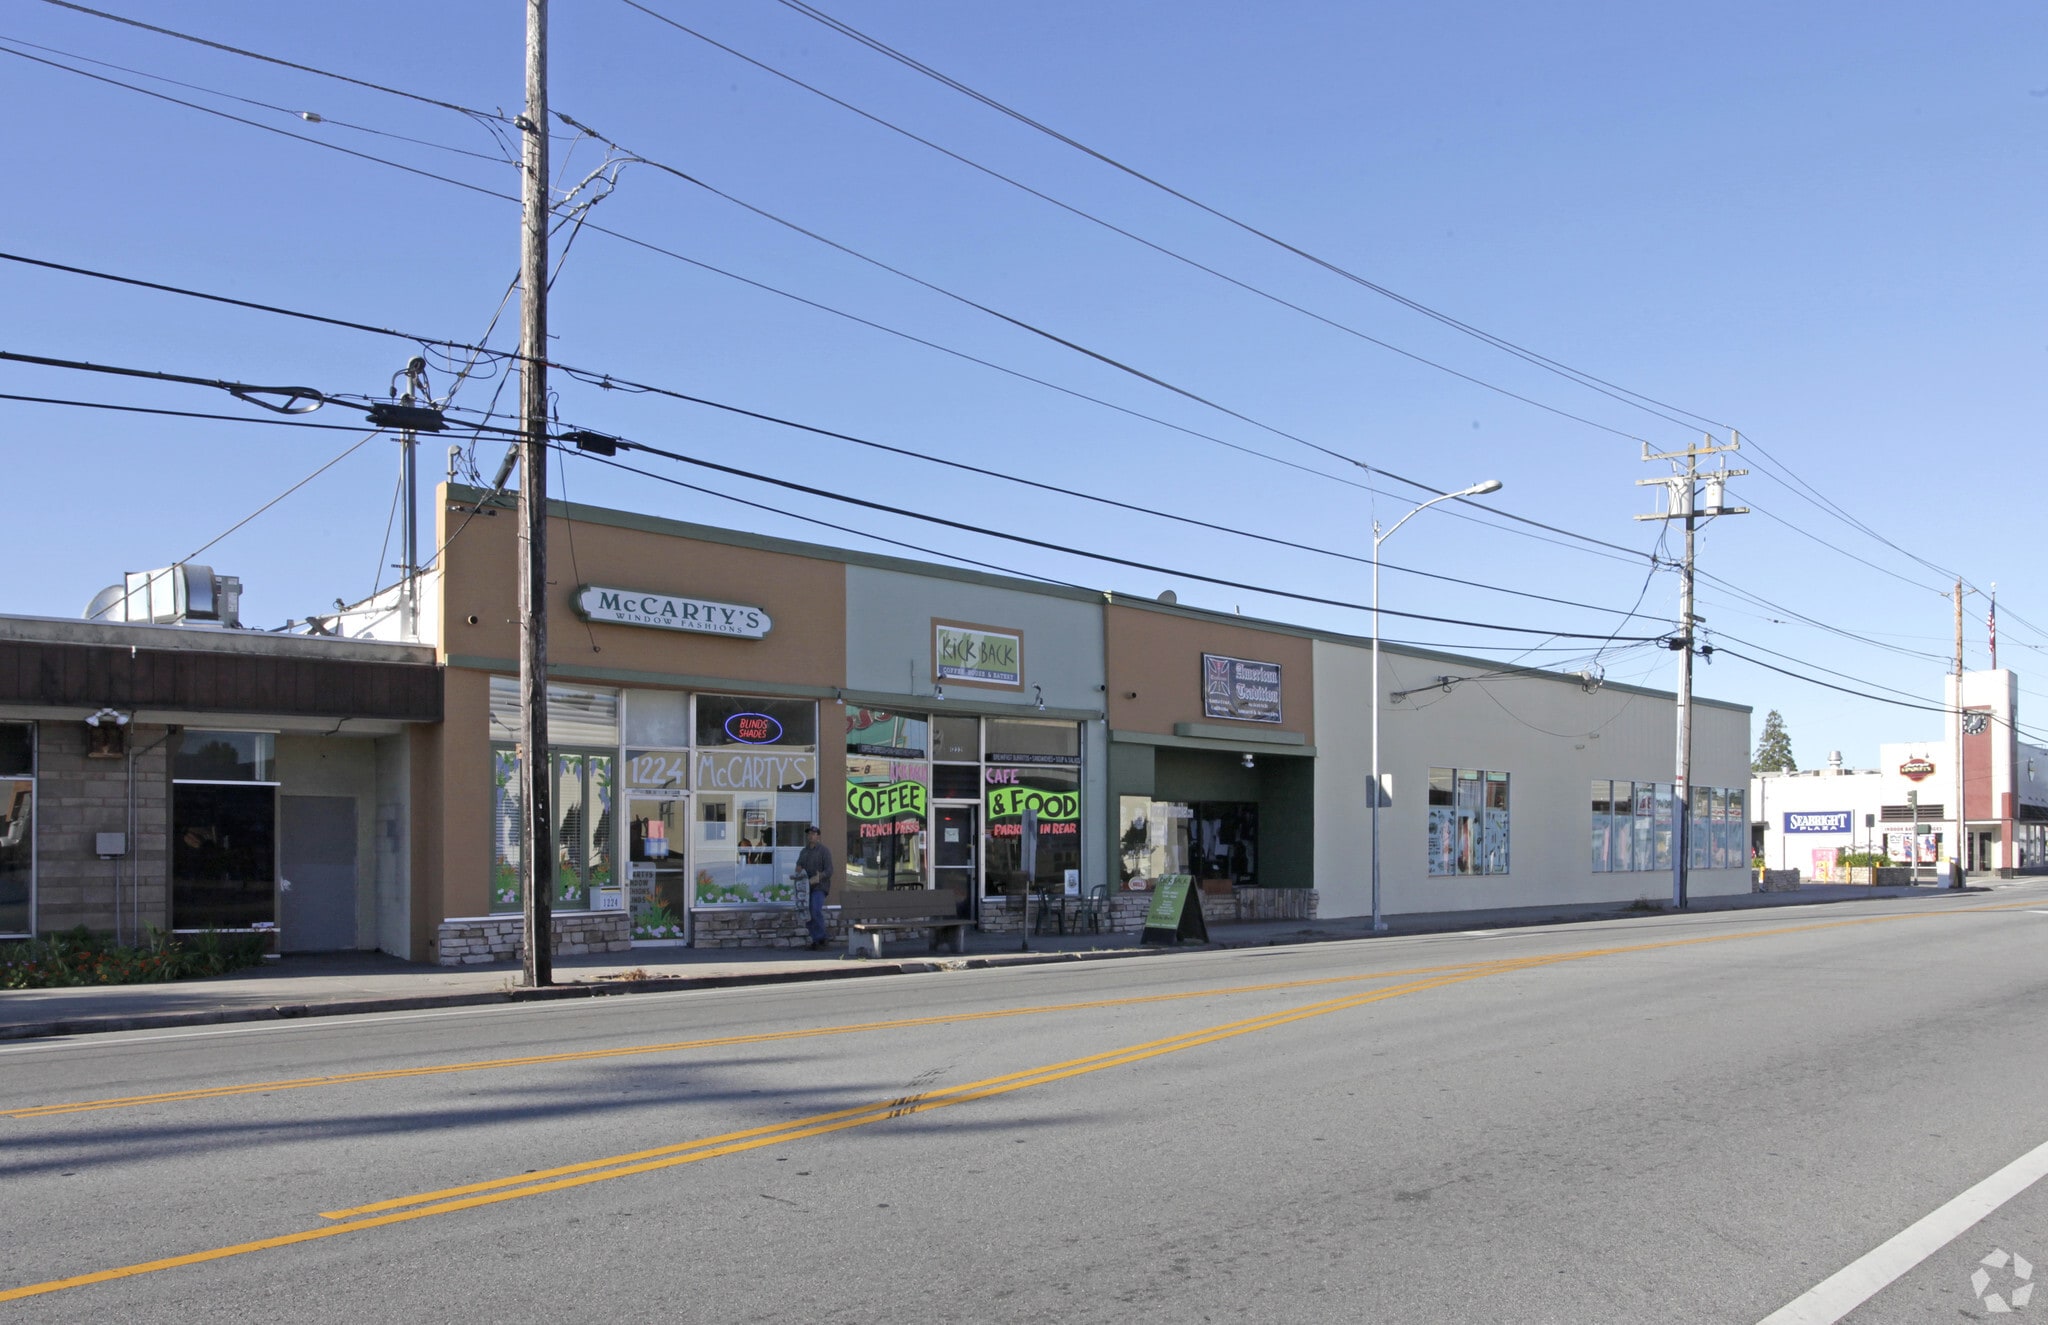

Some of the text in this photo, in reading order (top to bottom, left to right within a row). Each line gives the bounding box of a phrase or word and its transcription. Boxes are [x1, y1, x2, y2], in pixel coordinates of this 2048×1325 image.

[598, 592, 759, 628] McCARTY'S
[615, 613, 743, 633] WINDOW FASHIONS
[981, 642, 1014, 666] BACK
[943, 667, 965, 675] COFFEE
[967, 668, 986, 677] HOUSE
[993, 672, 1014, 680] EATERY
[1235, 663, 1278, 684] American
[1236, 683, 1278, 703] Tradition
[739, 719, 768, 729] BLINDS
[739, 729, 767, 739] SHADES
[632, 757, 683, 784] 1224
[698, 756, 807, 790] McCARTY'S
[985, 768, 1019, 784] CAFE
[848, 784, 921, 817] COFFEE
[993, 789, 1077, 818] & FOOD
[860, 820, 920, 838] FRENCH PRESS
[994, 823, 1077, 836] PARKI IN REAR
[1790, 813, 1847, 829] SEABRIGHT
[603, 897, 618, 908] 1224
